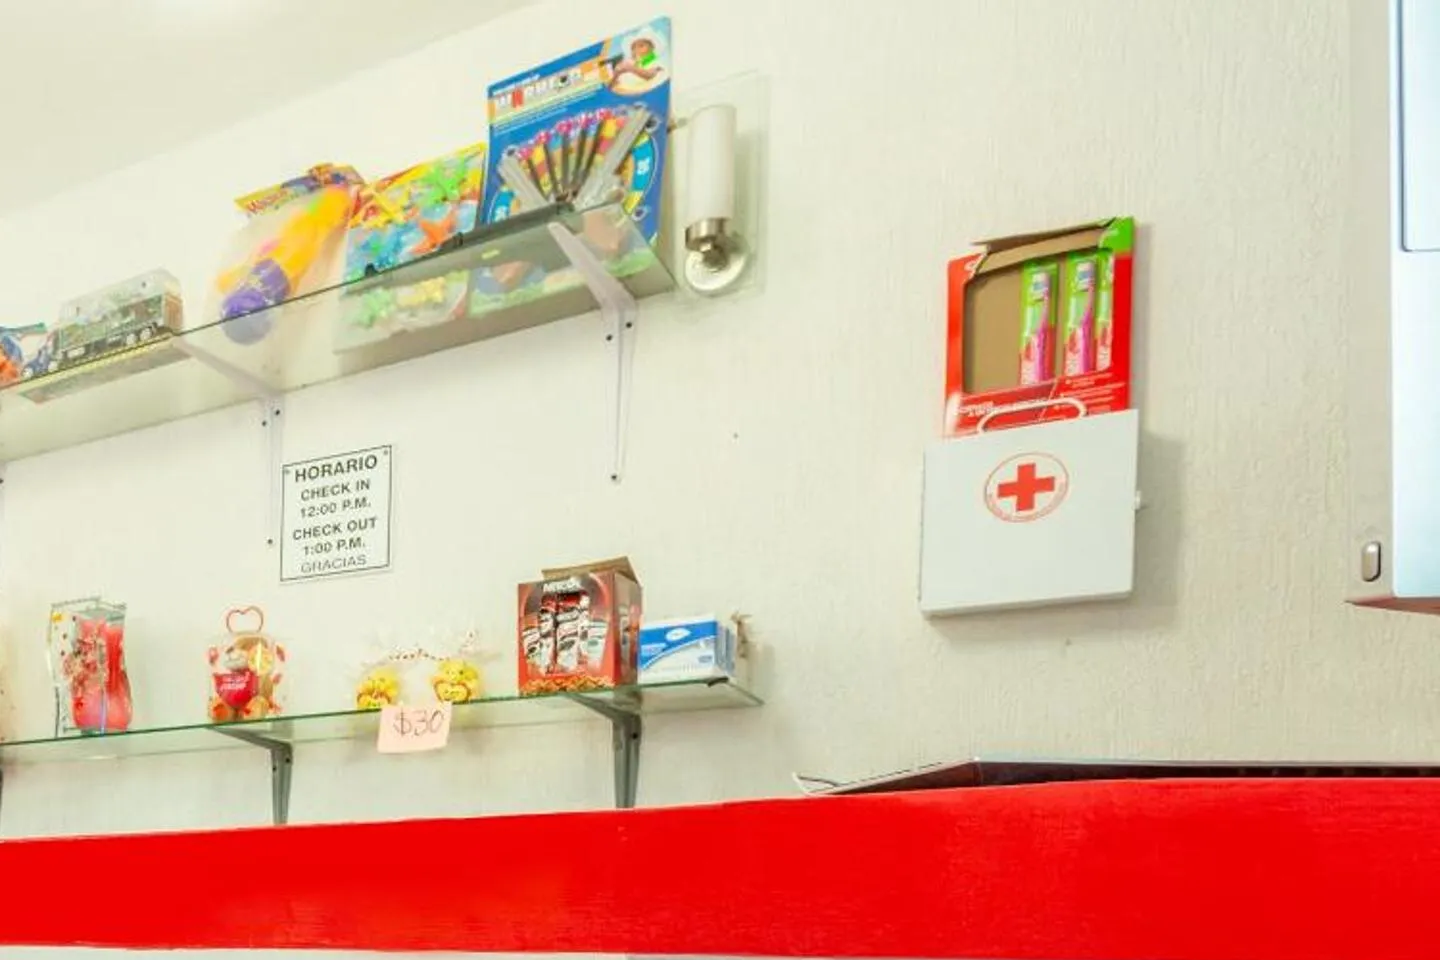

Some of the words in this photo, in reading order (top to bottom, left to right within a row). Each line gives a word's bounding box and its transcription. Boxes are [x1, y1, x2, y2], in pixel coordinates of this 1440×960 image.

[295, 454, 378, 482] HORARIO
[301, 482, 350, 501] CHECK
[356, 479, 370, 491] IN
[301, 502, 337, 518] 12:00
[342, 497, 371, 511] P.M.
[293, 523, 342, 540] CHECK
[347, 517, 378, 532] OUT
[303, 541, 332, 556] 1:00
[336, 537, 365, 551] P.M.
[301, 554, 367, 573] GRACIAS
[393, 705, 445, 737] $30
